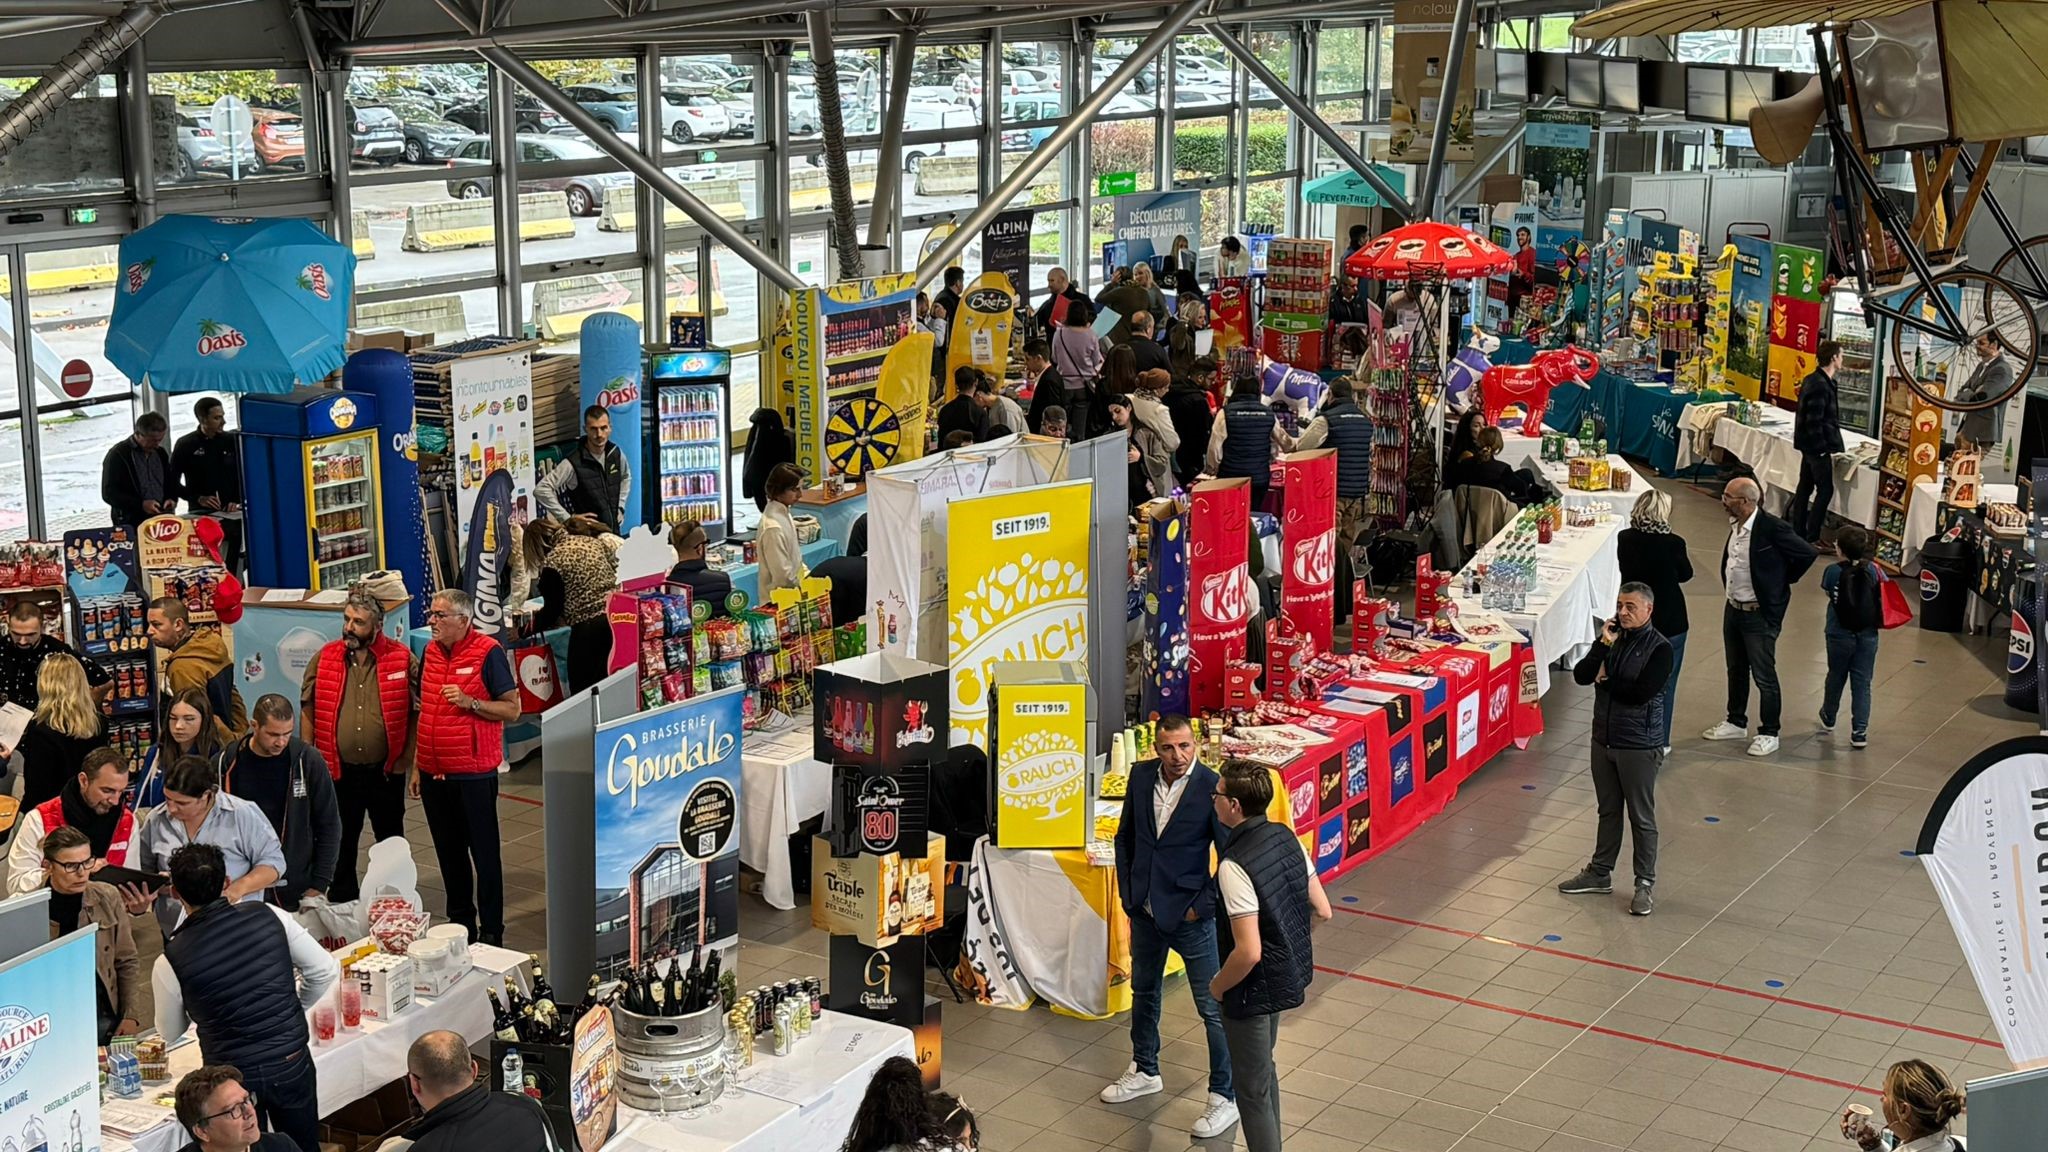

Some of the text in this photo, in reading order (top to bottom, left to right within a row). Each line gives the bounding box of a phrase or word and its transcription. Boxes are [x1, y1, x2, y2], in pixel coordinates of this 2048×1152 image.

[987, 219, 1029, 236] ALPINA
[1129, 208, 1185, 224] DÉCOLLAGE DU
[1514, 212, 1535, 223] PRIME
[1119, 226, 1150, 240] CHIFFRE
[309, 263, 330, 299] Oasis
[198, 330, 246, 355] Oasis
[796, 290, 809, 370] NOUVEAU
[456, 375, 528, 397] incontournables
[596, 382, 639, 408] Oasis
[799, 385, 813, 452] MEUBLE
[149, 520, 180, 539] Vico
[995, 516, 1050, 536] SEIT 1919.
[1015, 704, 1069, 713] SEIT 1919.
[642, 715, 707, 744] BRASSERIE
[607, 720, 736, 808] Goudale
[1019, 757, 1076, 786] RAUCH
[865, 811, 895, 840] 80
[824, 871, 865, 899] Triple
[4, 1090, 29, 1111] NATURE
